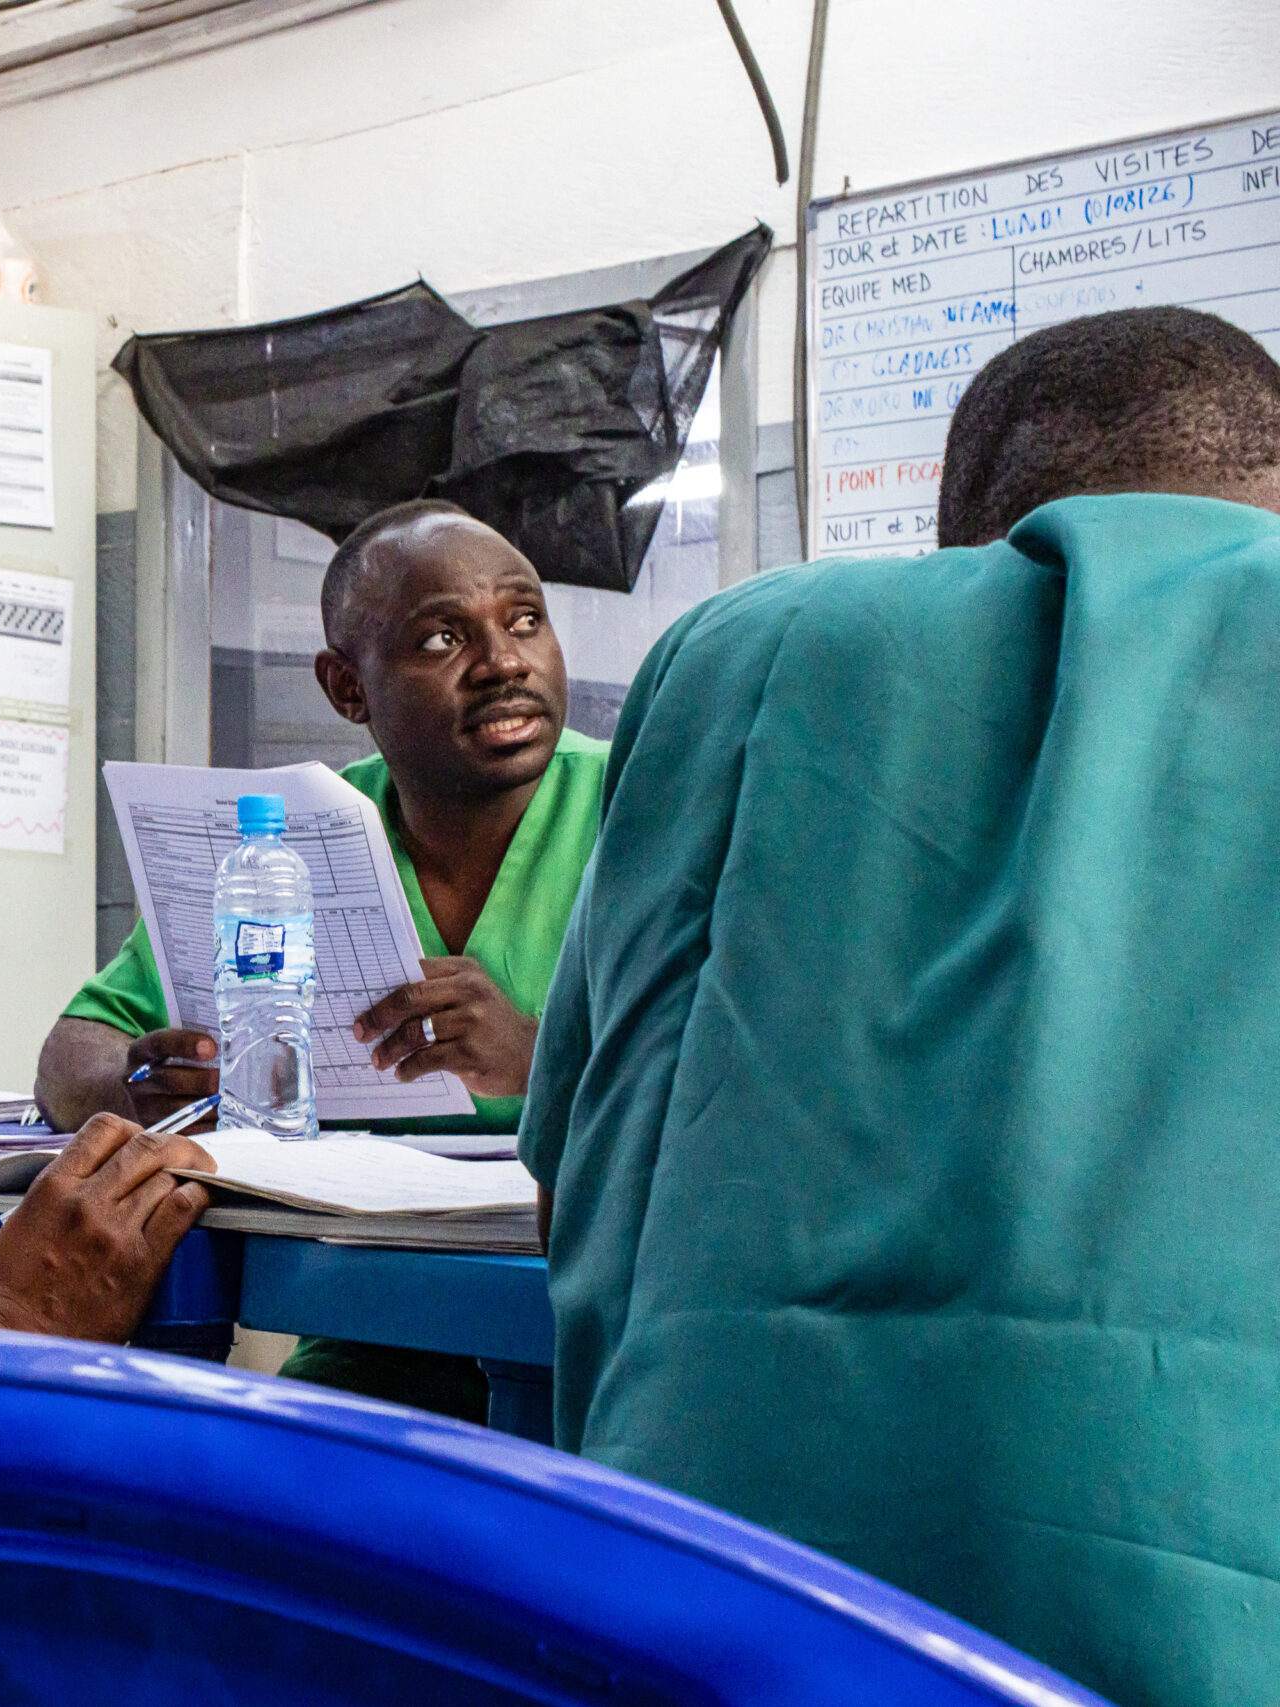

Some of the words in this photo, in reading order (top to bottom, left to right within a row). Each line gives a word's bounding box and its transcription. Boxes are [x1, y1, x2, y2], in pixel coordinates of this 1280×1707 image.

[838, 184, 988, 238] REPARTITION
[1025, 166, 1063, 196] DES
[1095, 137, 1214, 182] VISITES
[824, 241, 874, 270] JOUR
[881, 236, 899, 258] et
[992, 206, 1062, 240] LUNDI
[822, 280, 881, 310] EQUIPE
[892, 272, 932, 295] MED
[840, 464, 888, 493] POINT
[898, 461, 943, 486] FOCA
[826, 518, 876, 544] NUIT
[888, 515, 904, 534] et
[915, 516, 938, 534] DA
